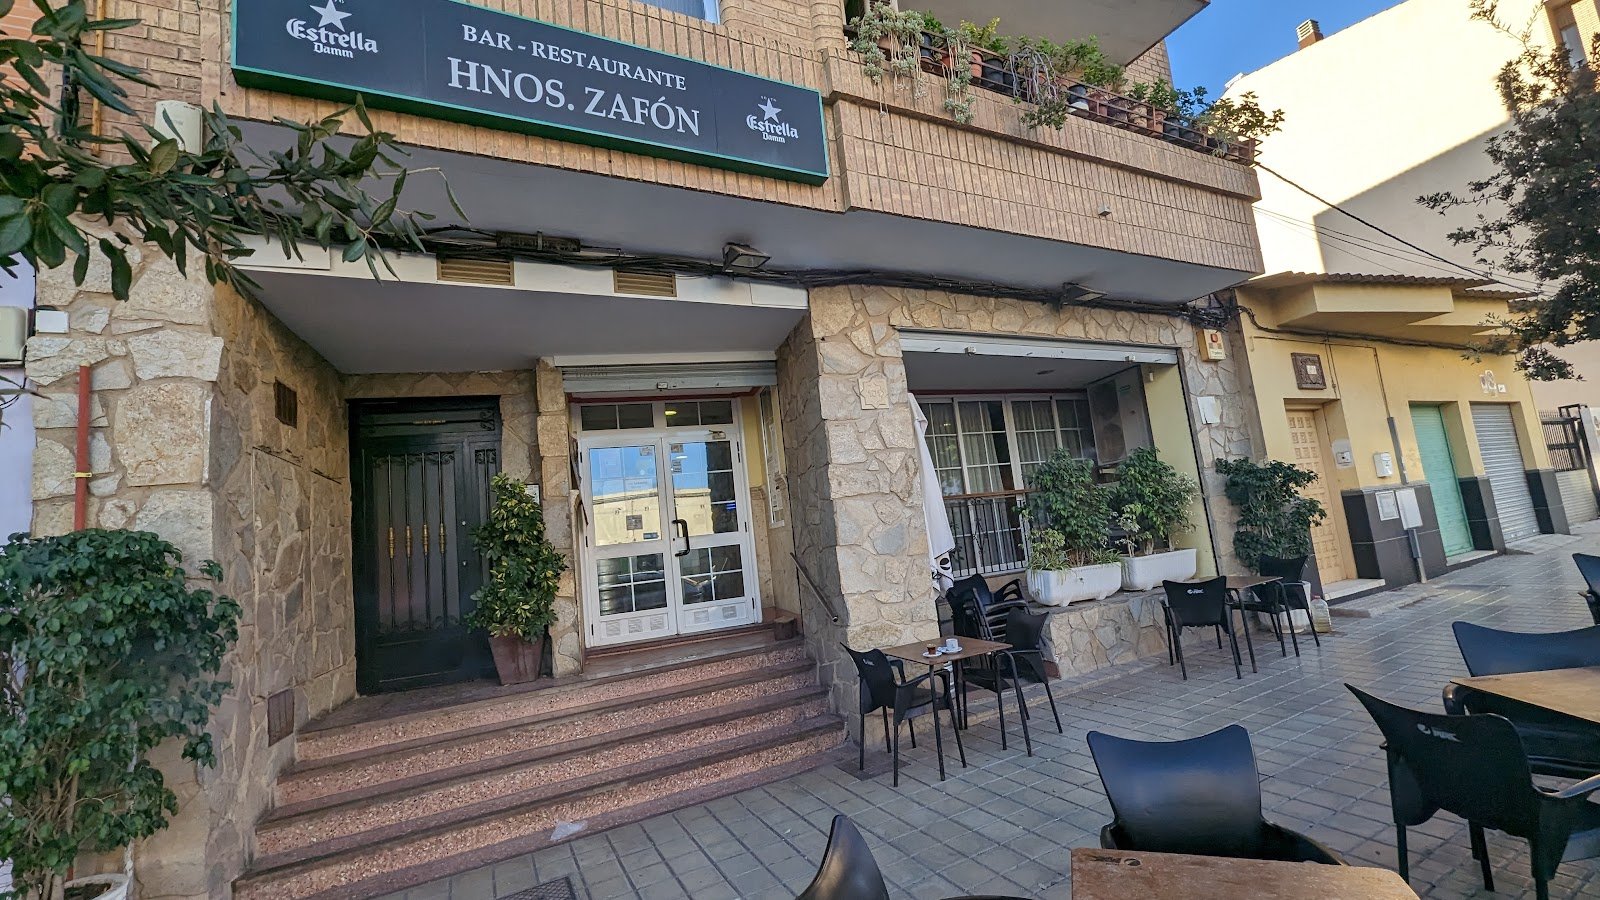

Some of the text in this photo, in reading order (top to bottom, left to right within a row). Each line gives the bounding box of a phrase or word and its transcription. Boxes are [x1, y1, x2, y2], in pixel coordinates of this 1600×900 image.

[286, 18, 378, 53] Estrella
[313, 42, 354, 59] Damm
[462, 24, 513, 51] BAR
[530, 40, 687, 91] RESTAURANTE
[447, 57, 700, 136] HNOS. ZAFÓN
[746, 114, 799, 139] Estrella
[762, 131, 786, 144] Damm
